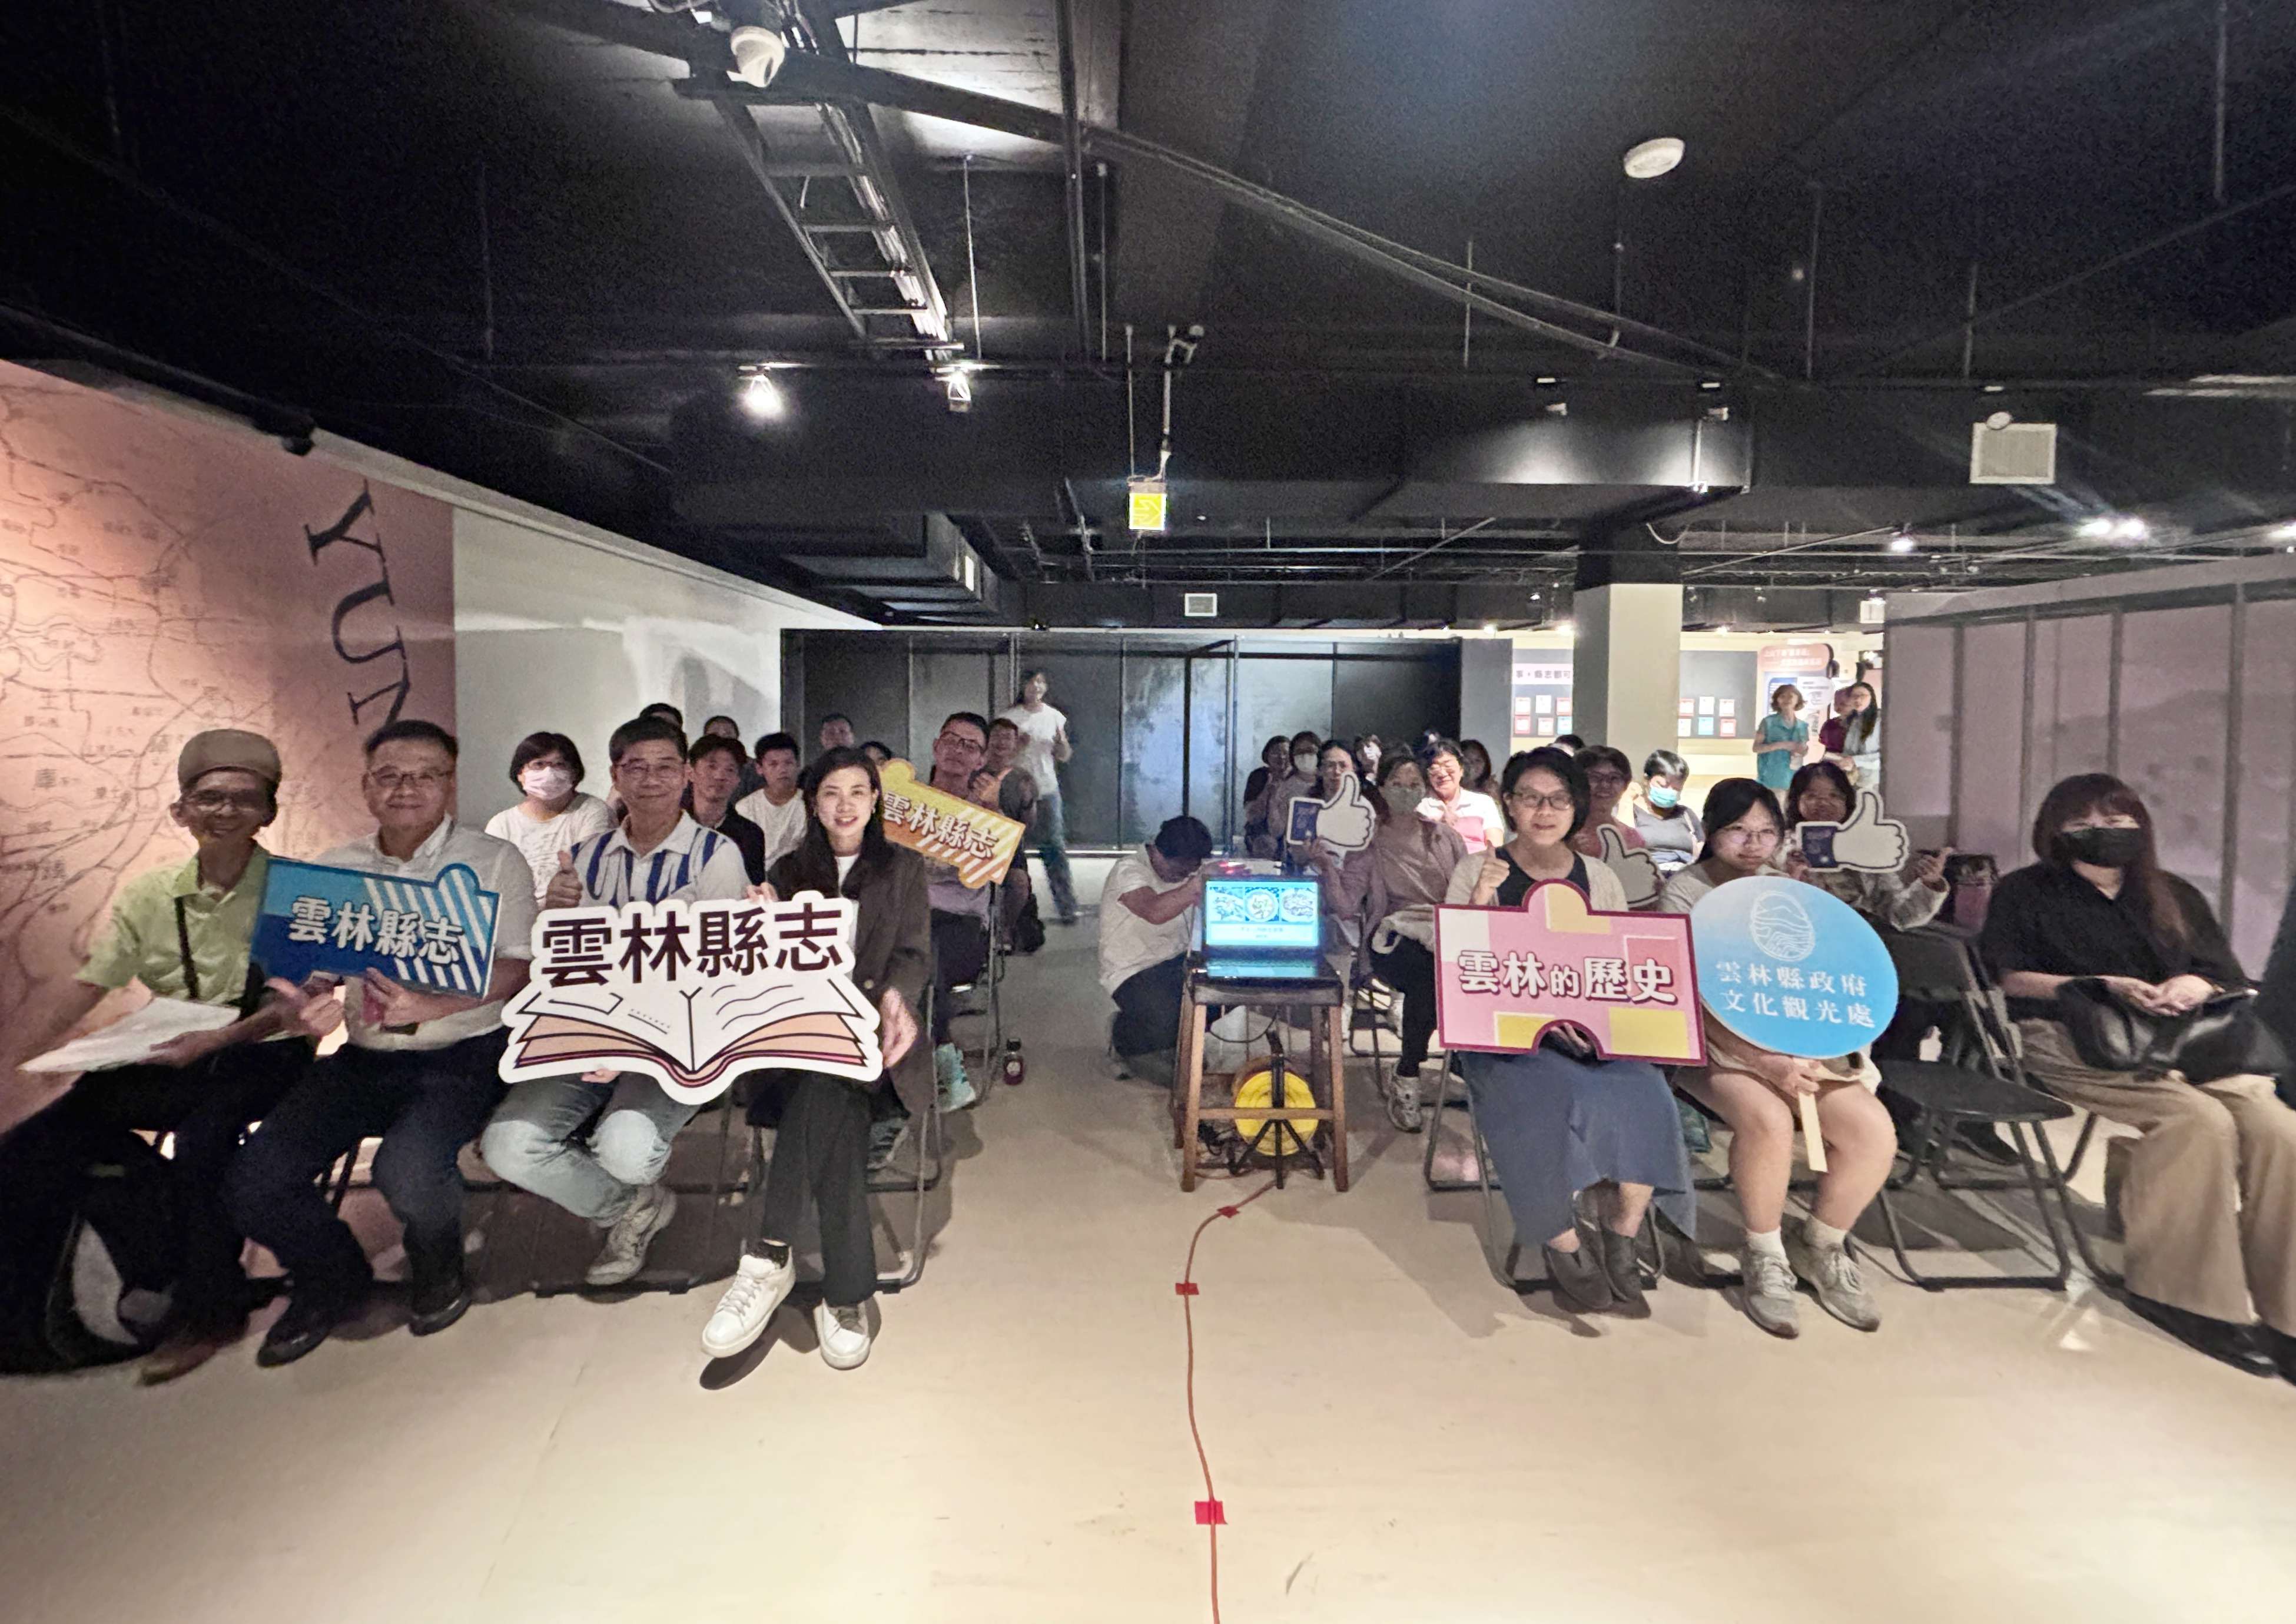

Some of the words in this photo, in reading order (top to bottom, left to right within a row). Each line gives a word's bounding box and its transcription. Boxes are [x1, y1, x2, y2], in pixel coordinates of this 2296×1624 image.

[884, 791, 998, 858] 雲林縣志
[288, 895, 463, 965] 雲林縣志
[542, 903, 842, 987] 雲林縣志
[1458, 950, 1677, 1005] 雲林的歷史
[1716, 961, 1866, 997] 雲林縣政府
[1720, 989, 1874, 1028] 文化觀光處
